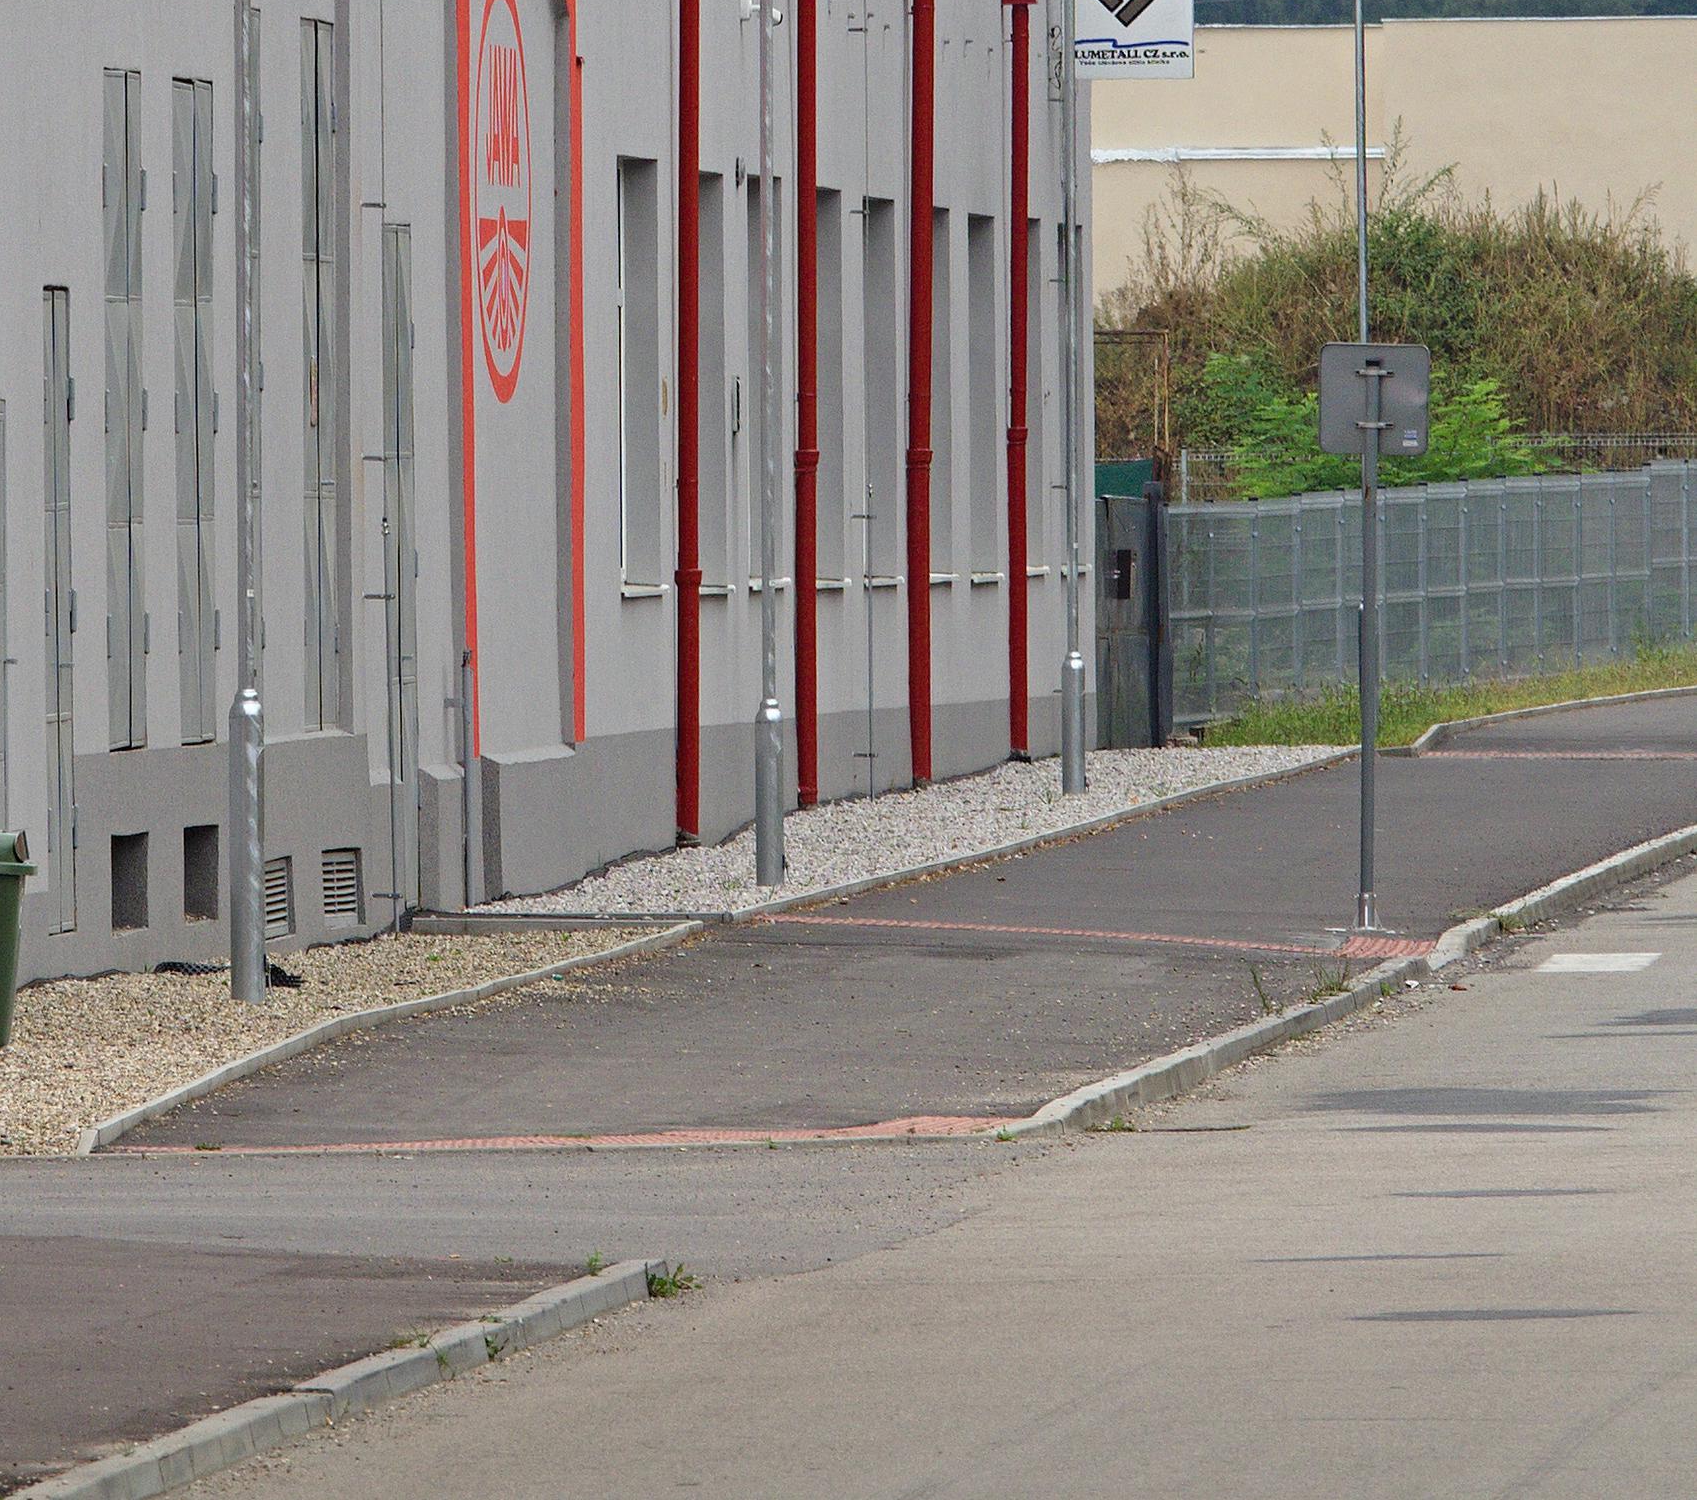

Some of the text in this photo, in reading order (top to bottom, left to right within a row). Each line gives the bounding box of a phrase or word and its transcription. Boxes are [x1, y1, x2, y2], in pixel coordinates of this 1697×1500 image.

[1143, 49, 1160, 59] CZ
[1162, 50, 1189, 59] s.r.o.
[485, 44, 521, 188] JAWA
